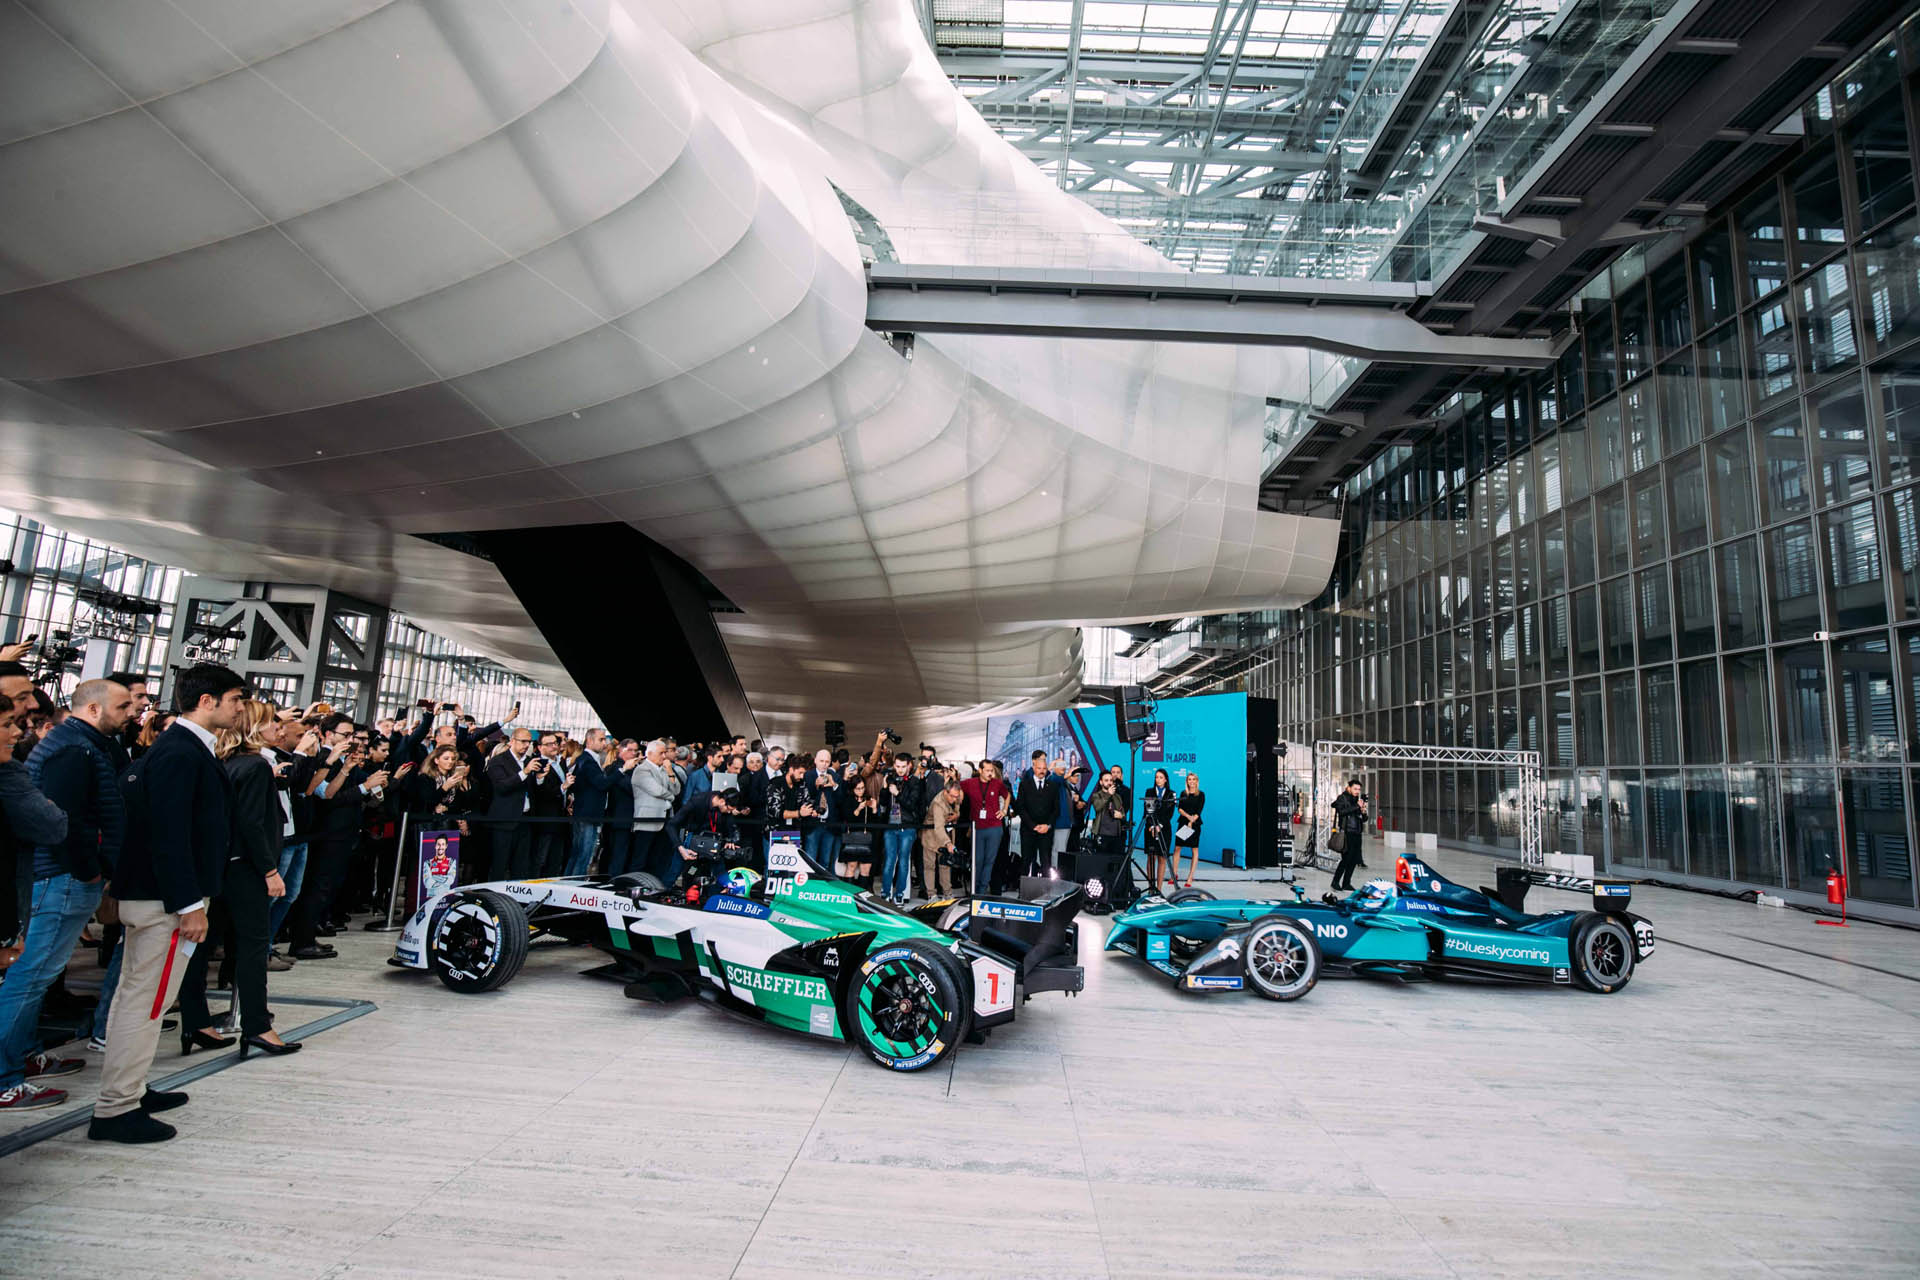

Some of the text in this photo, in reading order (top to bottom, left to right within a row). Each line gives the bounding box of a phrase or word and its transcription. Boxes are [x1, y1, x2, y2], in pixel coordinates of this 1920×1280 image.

[1409, 864, 1429, 877] FIL
[505, 885, 533, 896] KUKA
[764, 877, 793, 896] DIG
[569, 893, 639, 913] Audi e-tron
[716, 898, 763, 916] Julius Bär
[798, 891, 853, 905] SCHAEFFLER
[1406, 900, 1427, 911] Julius
[991, 907, 1037, 917] MCHELIN
[1316, 924, 1348, 939] NIO
[1637, 930, 1655, 948] 68
[1445, 938, 1550, 964] #blueskycoming
[726, 965, 827, 1001] SCHAEFFLER
[987, 972, 999, 1005] 1
